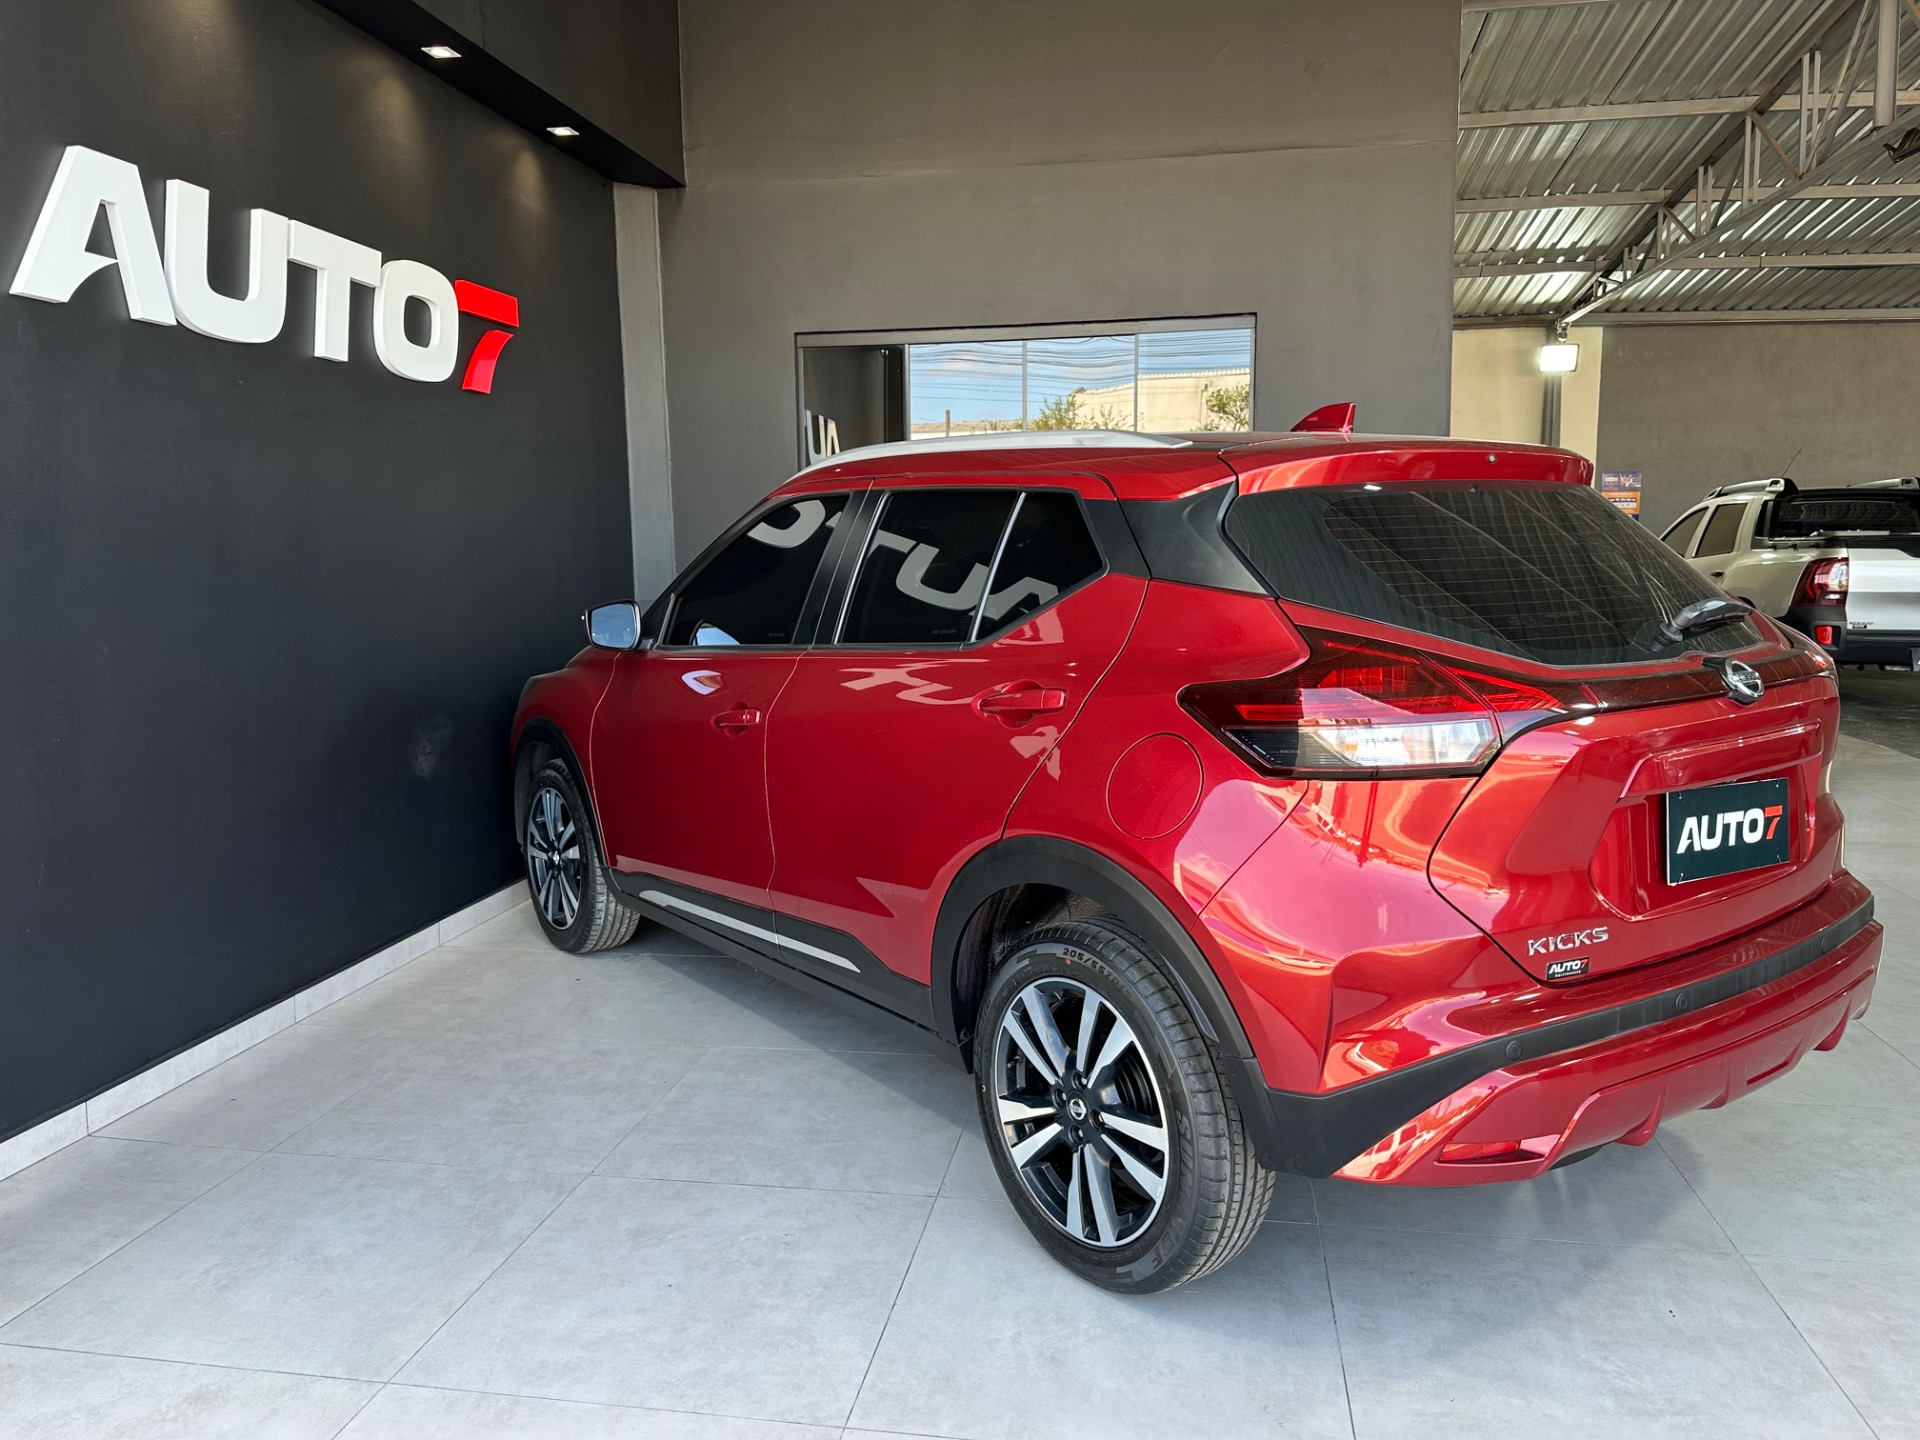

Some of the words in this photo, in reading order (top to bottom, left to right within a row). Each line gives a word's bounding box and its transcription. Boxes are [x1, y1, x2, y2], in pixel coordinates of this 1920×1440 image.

[9, 144, 520, 395] AUTO7
[1677, 805, 1783, 854] AUTO7
[1527, 926, 1609, 957] KICKS
[1548, 959, 1588, 975] AUTO7
